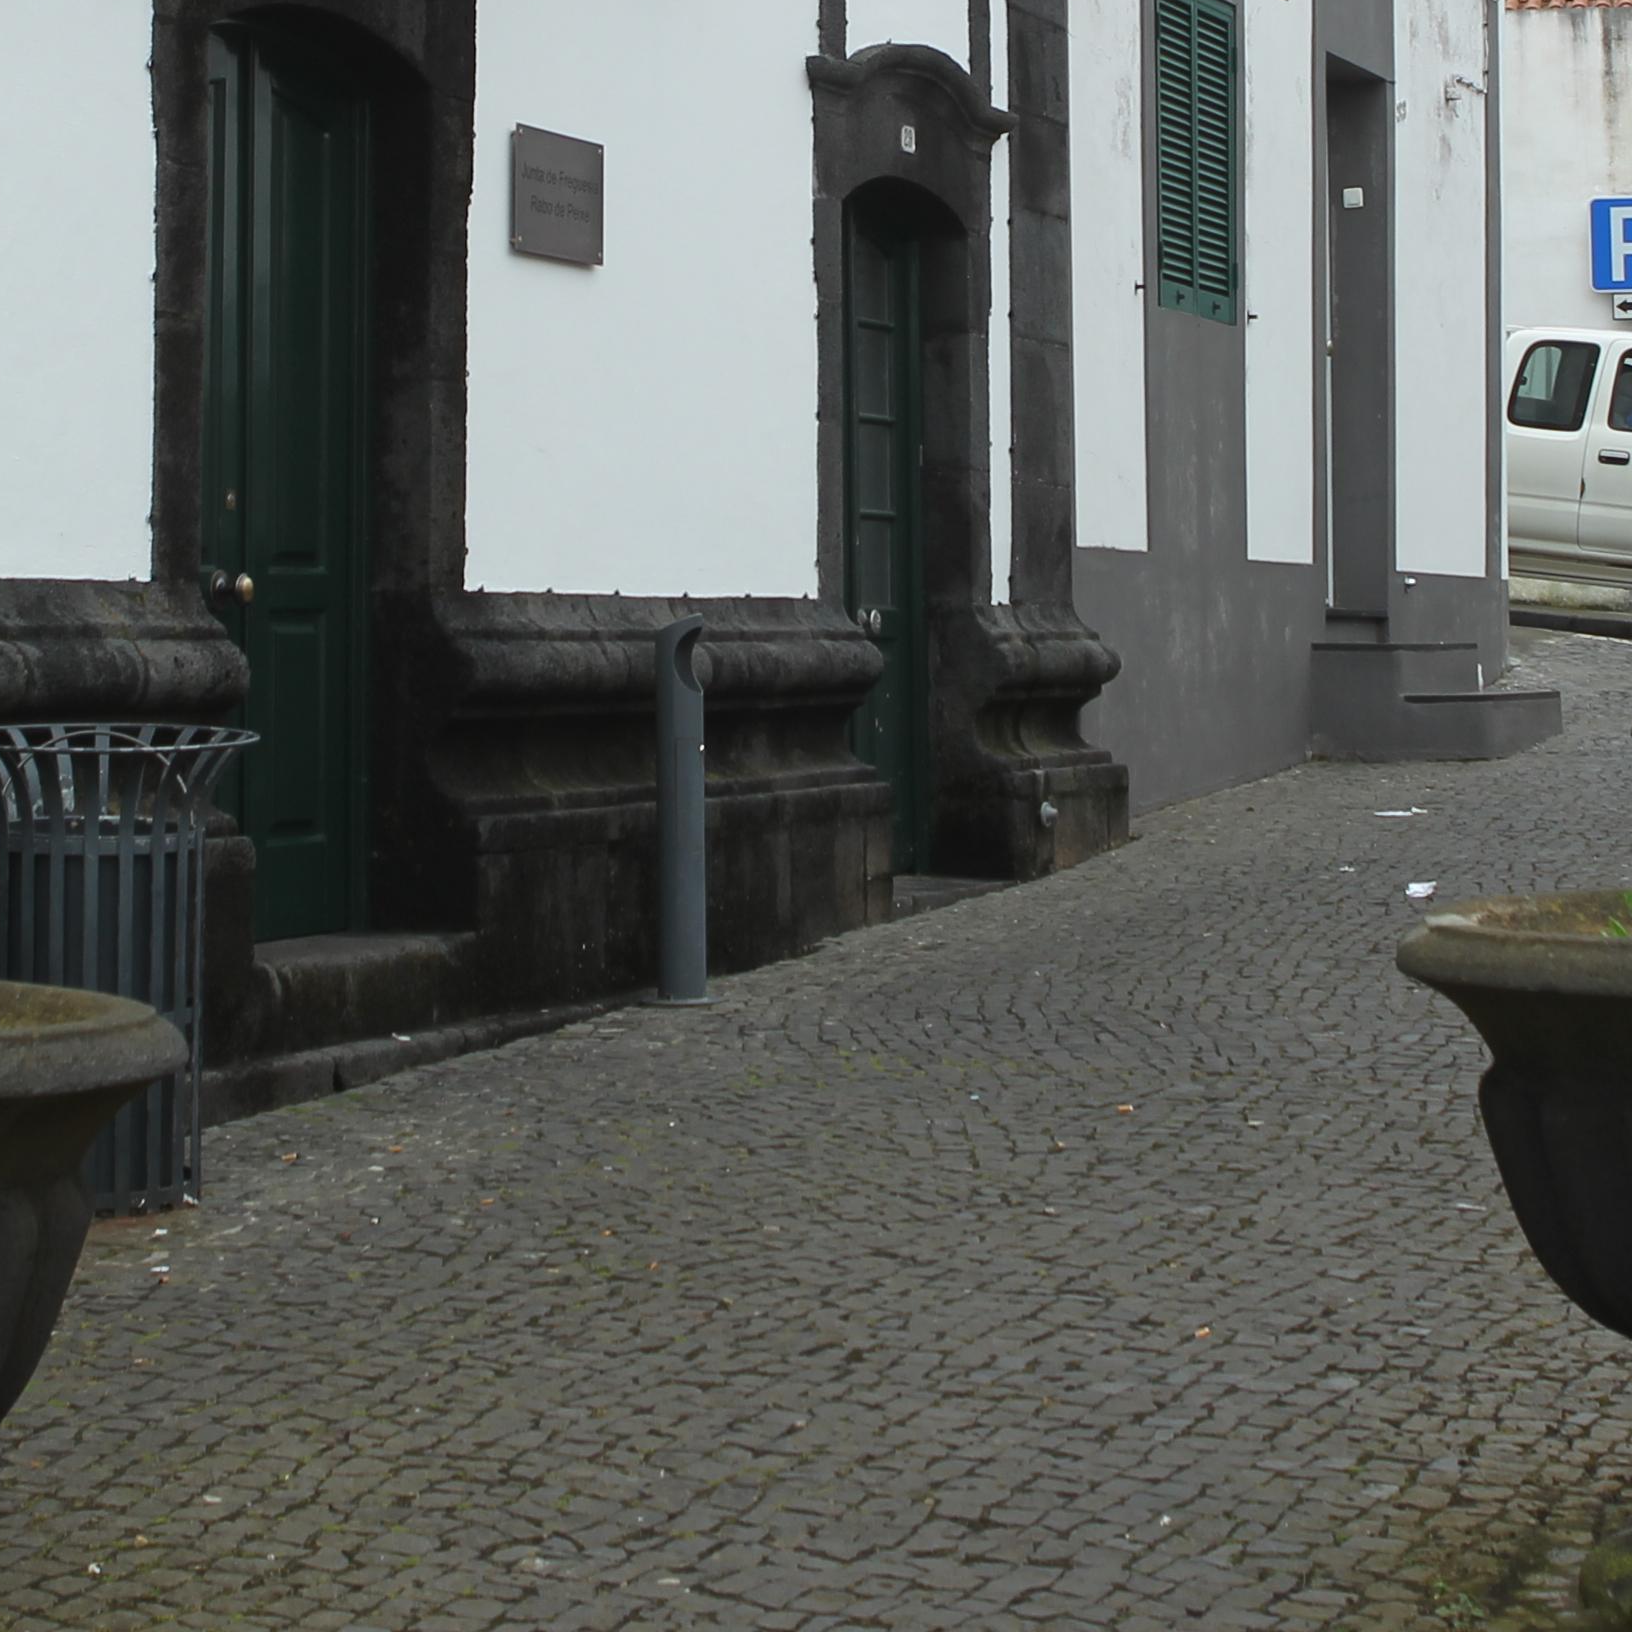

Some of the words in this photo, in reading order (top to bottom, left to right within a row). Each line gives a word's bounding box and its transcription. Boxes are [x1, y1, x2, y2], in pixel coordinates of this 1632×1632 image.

[521, 161, 545, 183] Junta
[546, 168, 557, 185] de
[530, 194, 553, 216] Rabo
